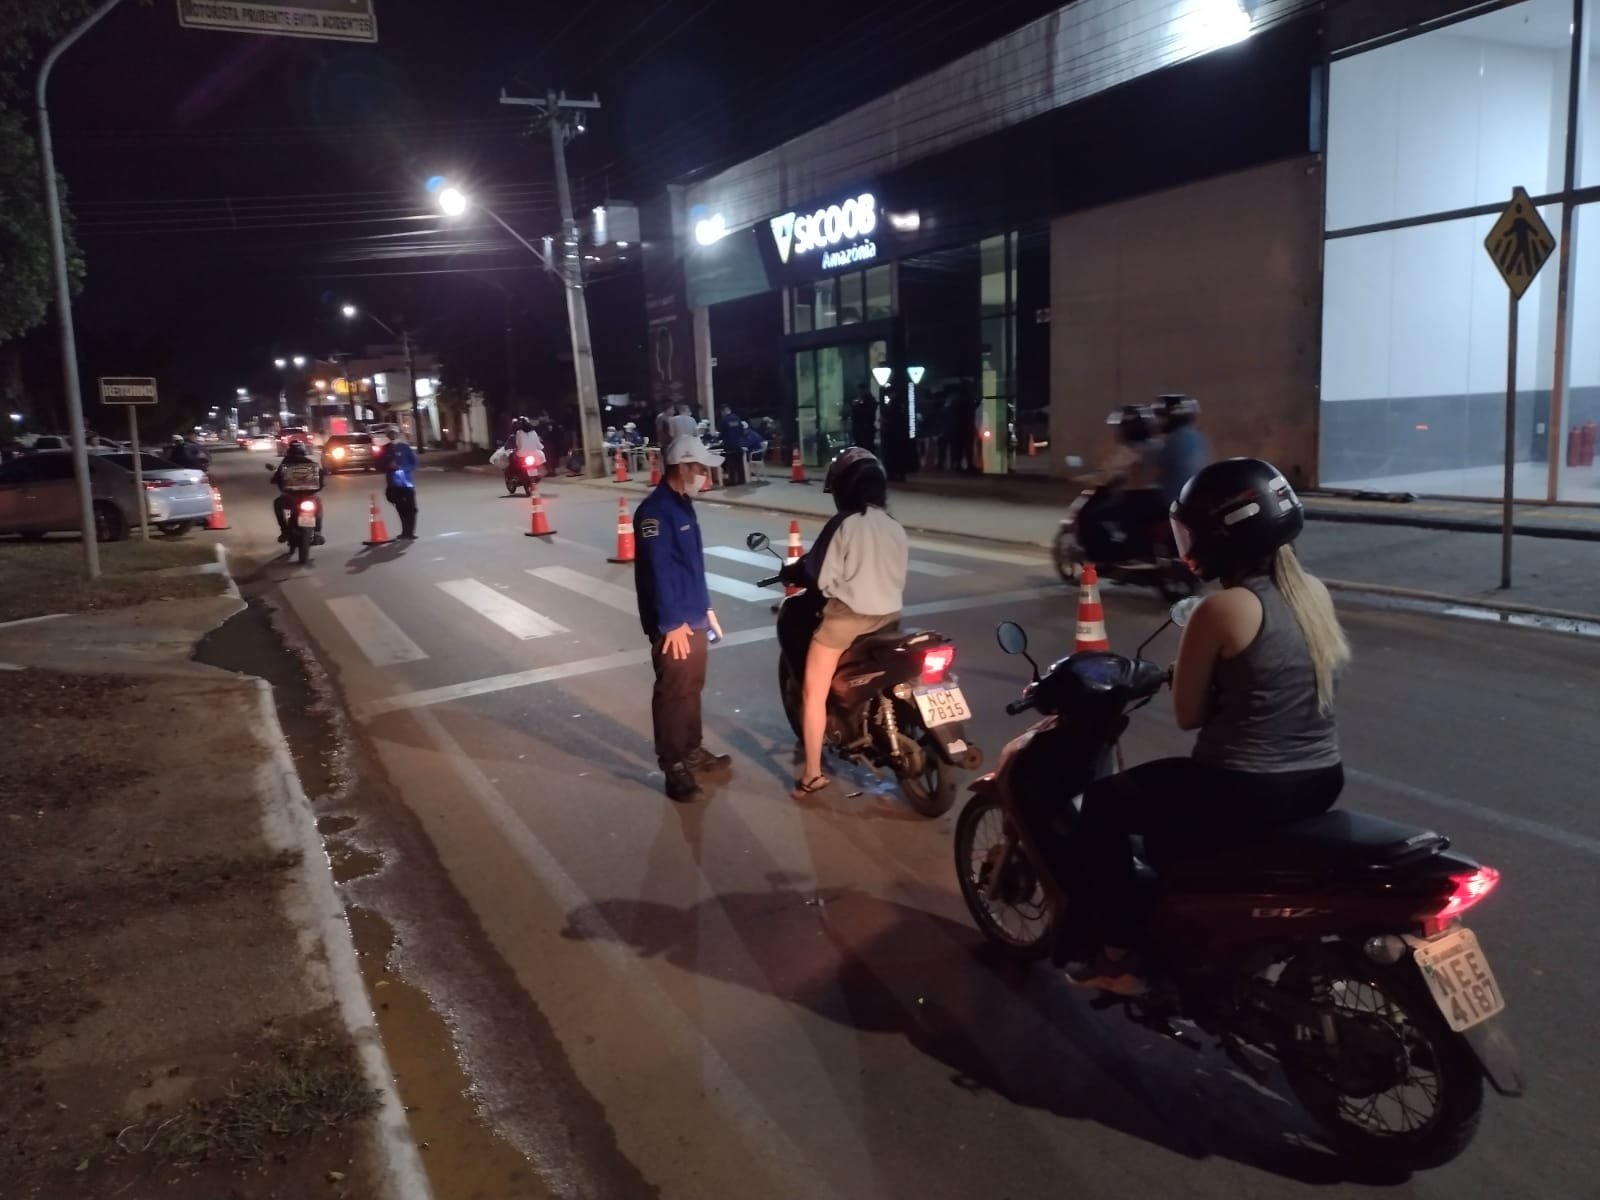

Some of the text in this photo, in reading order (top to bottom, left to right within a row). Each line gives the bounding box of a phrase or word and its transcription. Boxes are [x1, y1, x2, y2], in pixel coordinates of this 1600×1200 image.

[794, 193, 876, 254] SICOOB
[1432, 951, 1486, 997] NEE
[1450, 979, 1498, 1025] 4187
